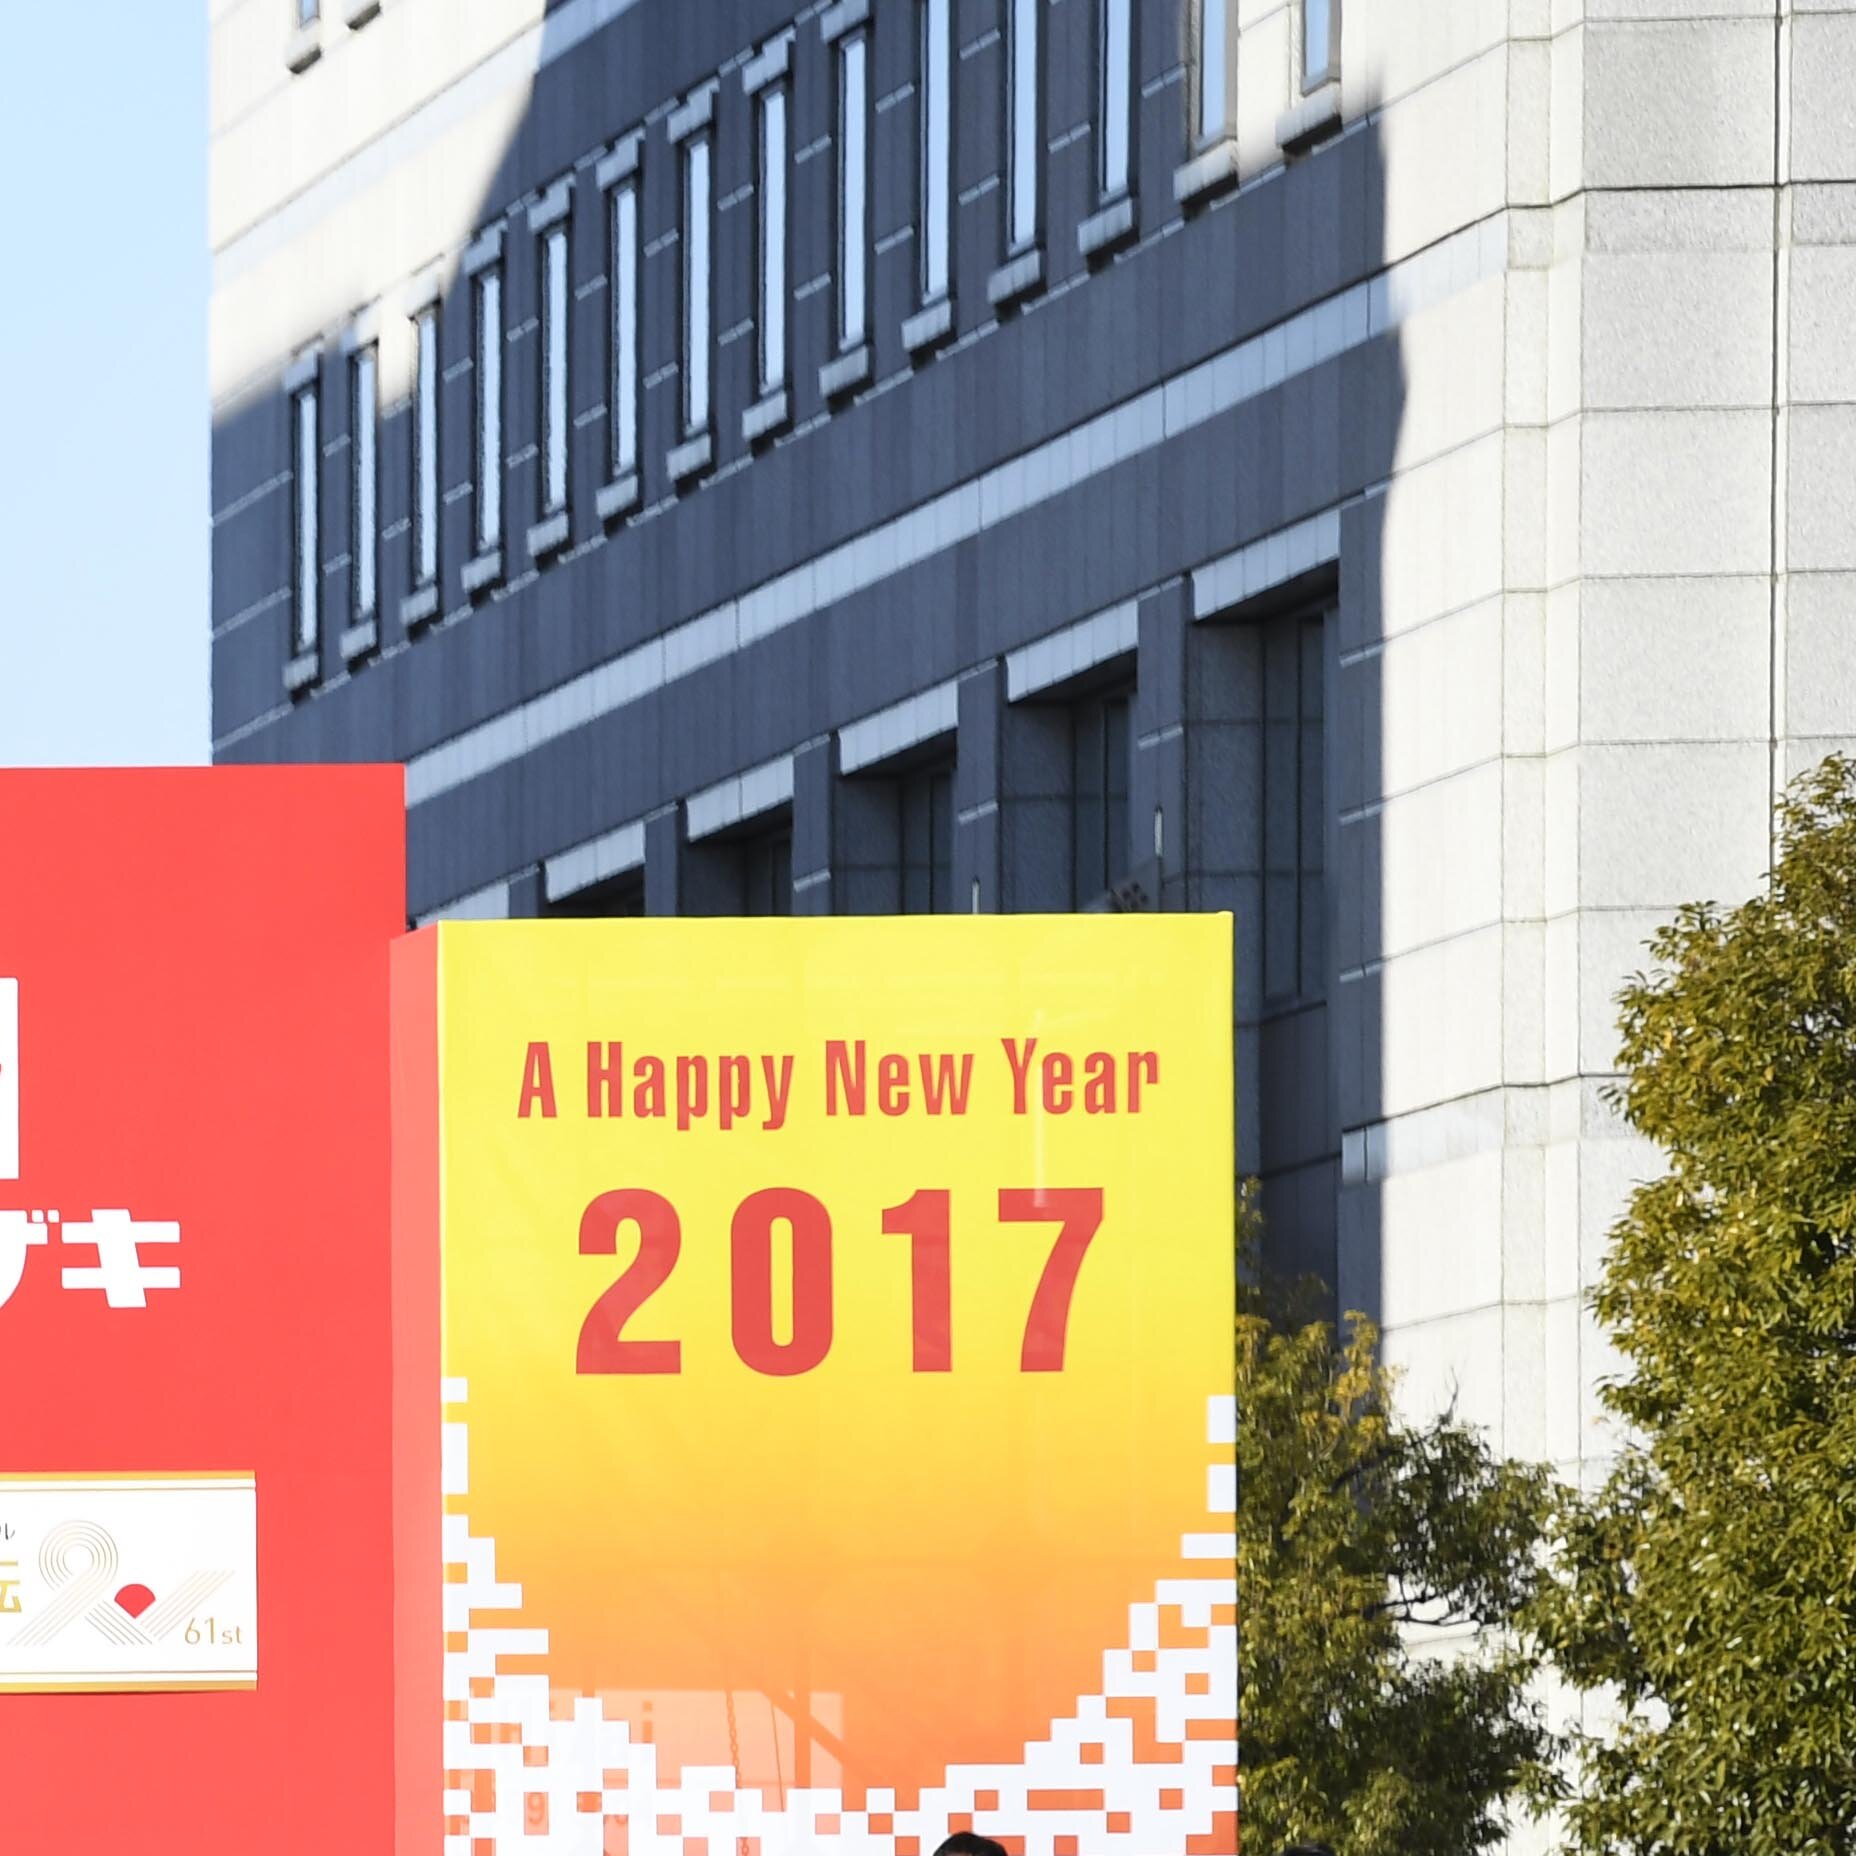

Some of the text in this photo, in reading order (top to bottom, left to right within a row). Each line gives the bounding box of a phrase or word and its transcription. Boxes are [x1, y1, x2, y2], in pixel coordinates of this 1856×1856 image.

[517, 1037, 1160, 1131] A Happy New Year
[574, 1186, 1105, 1376] 2017
[184, 1618, 245, 1647] 61st
